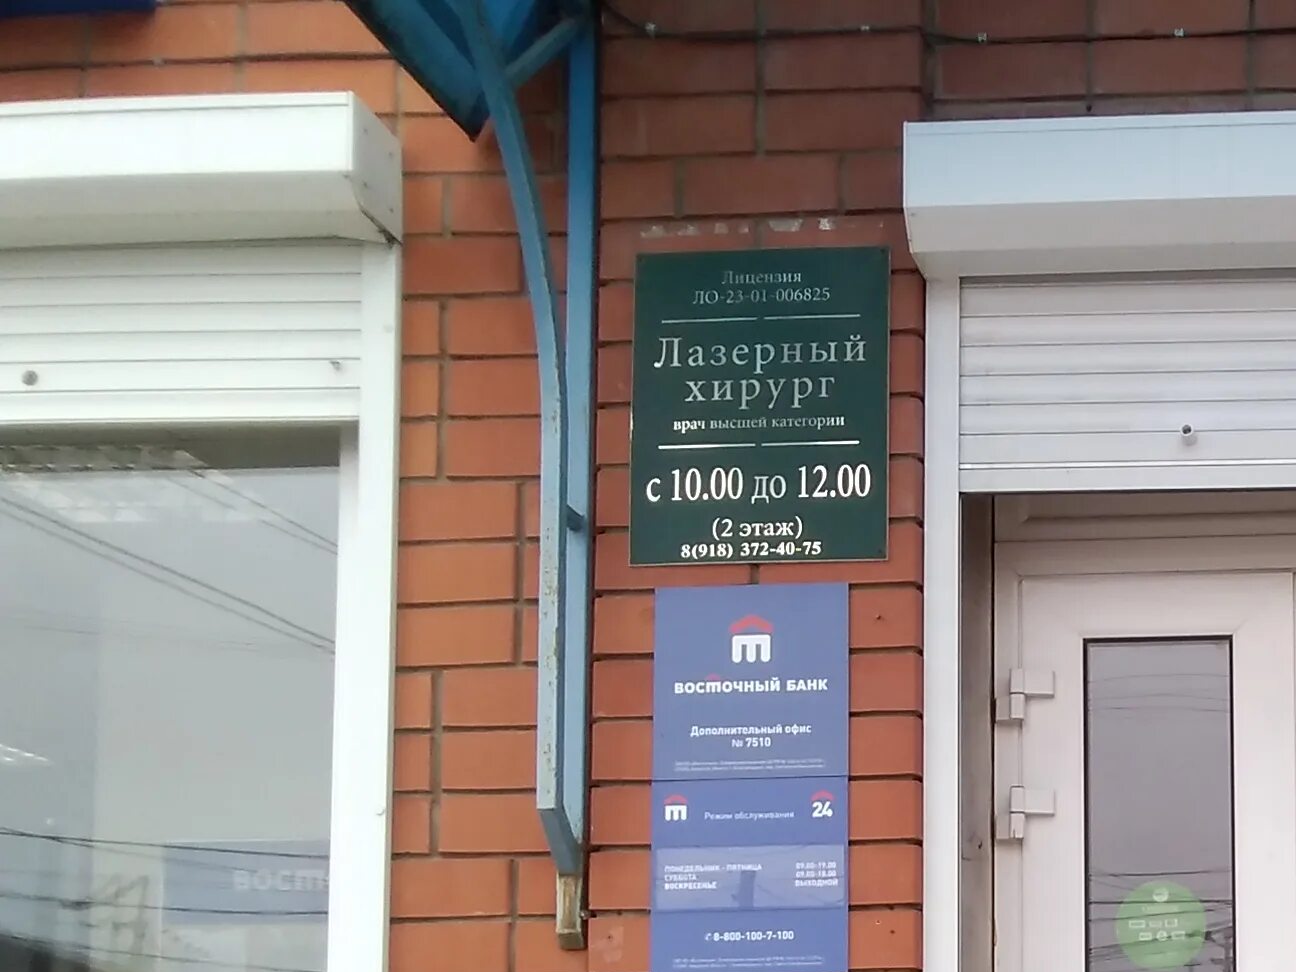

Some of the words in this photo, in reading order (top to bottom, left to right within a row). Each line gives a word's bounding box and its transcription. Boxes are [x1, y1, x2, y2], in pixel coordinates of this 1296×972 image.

[722, 270, 802, 285] Лицензия
[692, 287, 831, 305] ЛО-23-01-006825
[653, 334, 867, 375] Лазерный
[684, 376, 835, 410] хирург
[673, 419, 706, 434] врач
[710, 417, 767, 429] высшей
[771, 416, 845, 430] категории
[646, 476, 662, 503] с
[671, 467, 744, 501] 10.00
[751, 475, 787, 504] до
[798, 463, 871, 498] 12.00
[712, 518, 734, 541] (2
[739, 516, 803, 539] этаж)
[681, 543, 734, 559] 8(918)
[740, 541, 822, 557] 372-40-75
[786, 679, 828, 692] БАНК
[690, 724, 783, 738] Дополнительный
[785, 724, 812, 736] офис
[731, 738, 743, 748] №
[745, 737, 772, 748] 7510
[704, 811, 733, 820] Режим
[734, 810, 795, 822] обслуживания
[811, 801, 833, 818] 24
[713, 930, 794, 942] 8-800-100-7-100
